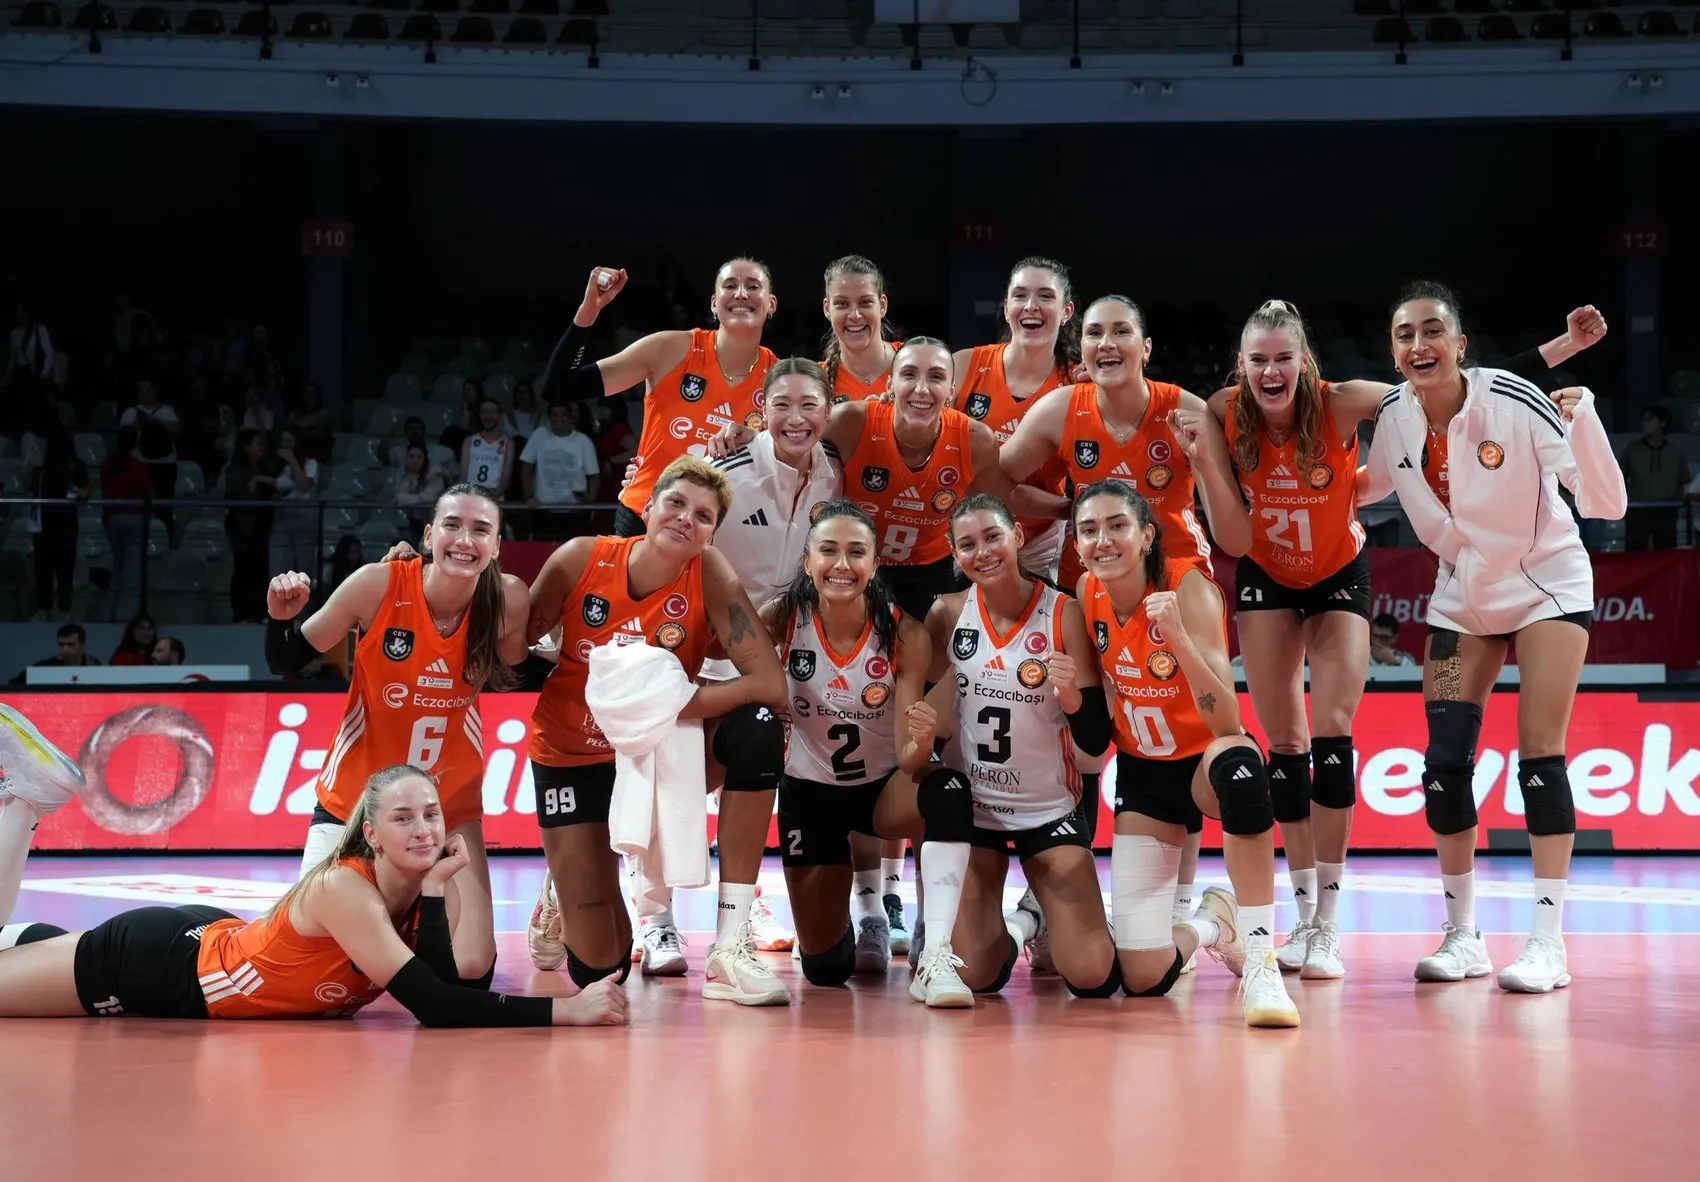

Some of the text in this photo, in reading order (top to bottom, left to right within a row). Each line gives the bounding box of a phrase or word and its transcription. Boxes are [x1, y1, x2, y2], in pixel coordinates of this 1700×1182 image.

[312, 230, 346, 247] 110
[964, 225, 993, 240] 111
[1623, 232, 1657, 249] 112
[477, 464, 489, 482] 8
[1260, 507, 1313, 552] 21
[881, 524, 919, 562] 8
[591, 597, 604, 605] CEV
[1240, 586, 1263, 602] 21
[974, 683, 1045, 706] Eczacıbaşı
[977, 705, 1012, 764] 3
[1123, 700, 1177, 756] 10
[406, 716, 448, 771] 6
[827, 723, 867, 781] 2
[971, 763, 1021, 786] PERON
[544, 786, 577, 816] 99
[788, 829, 803, 855] 2
